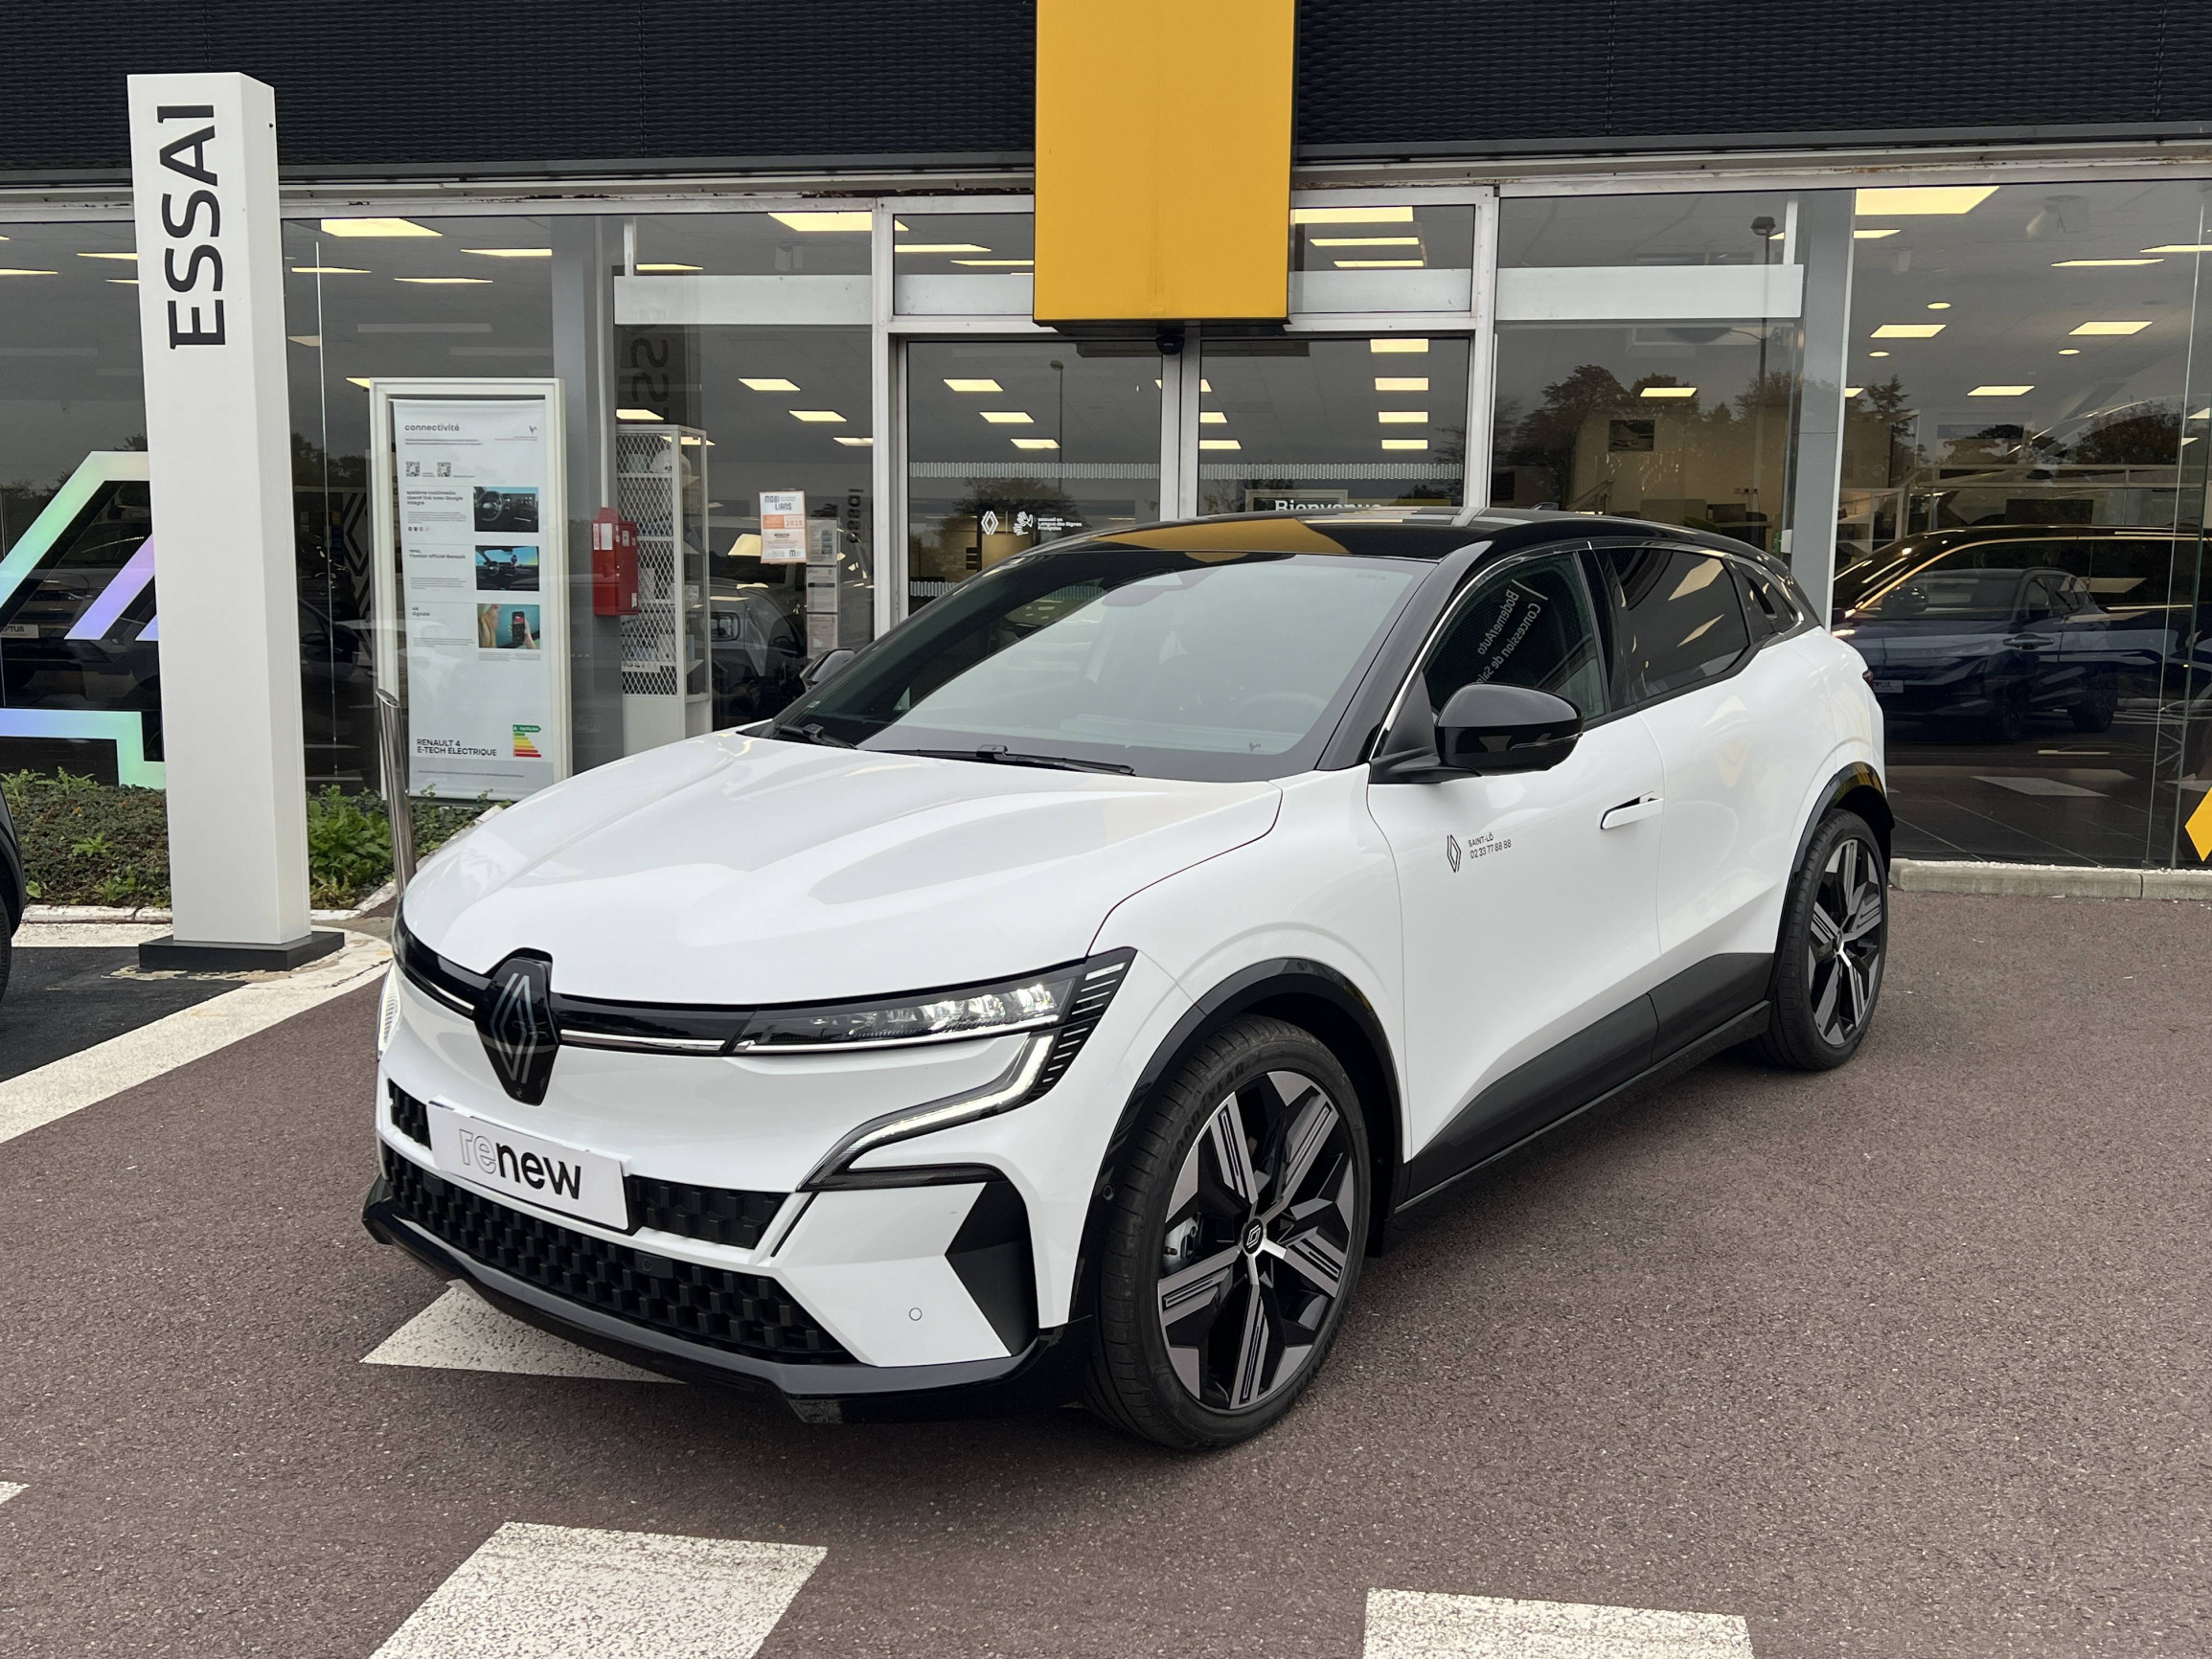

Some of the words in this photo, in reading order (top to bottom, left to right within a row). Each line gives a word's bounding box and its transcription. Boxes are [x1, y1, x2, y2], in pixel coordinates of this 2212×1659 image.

[157, 105, 226, 350] ESSAI
[417, 739, 454, 747] RENAULT
[1469, 832, 1494, 847] SAINT-LÔ
[1470, 850, 1478, 858] 02
[1479, 847, 1486, 856] 33
[1487, 844, 1494, 853] 77
[459, 1128, 582, 1200] renew
